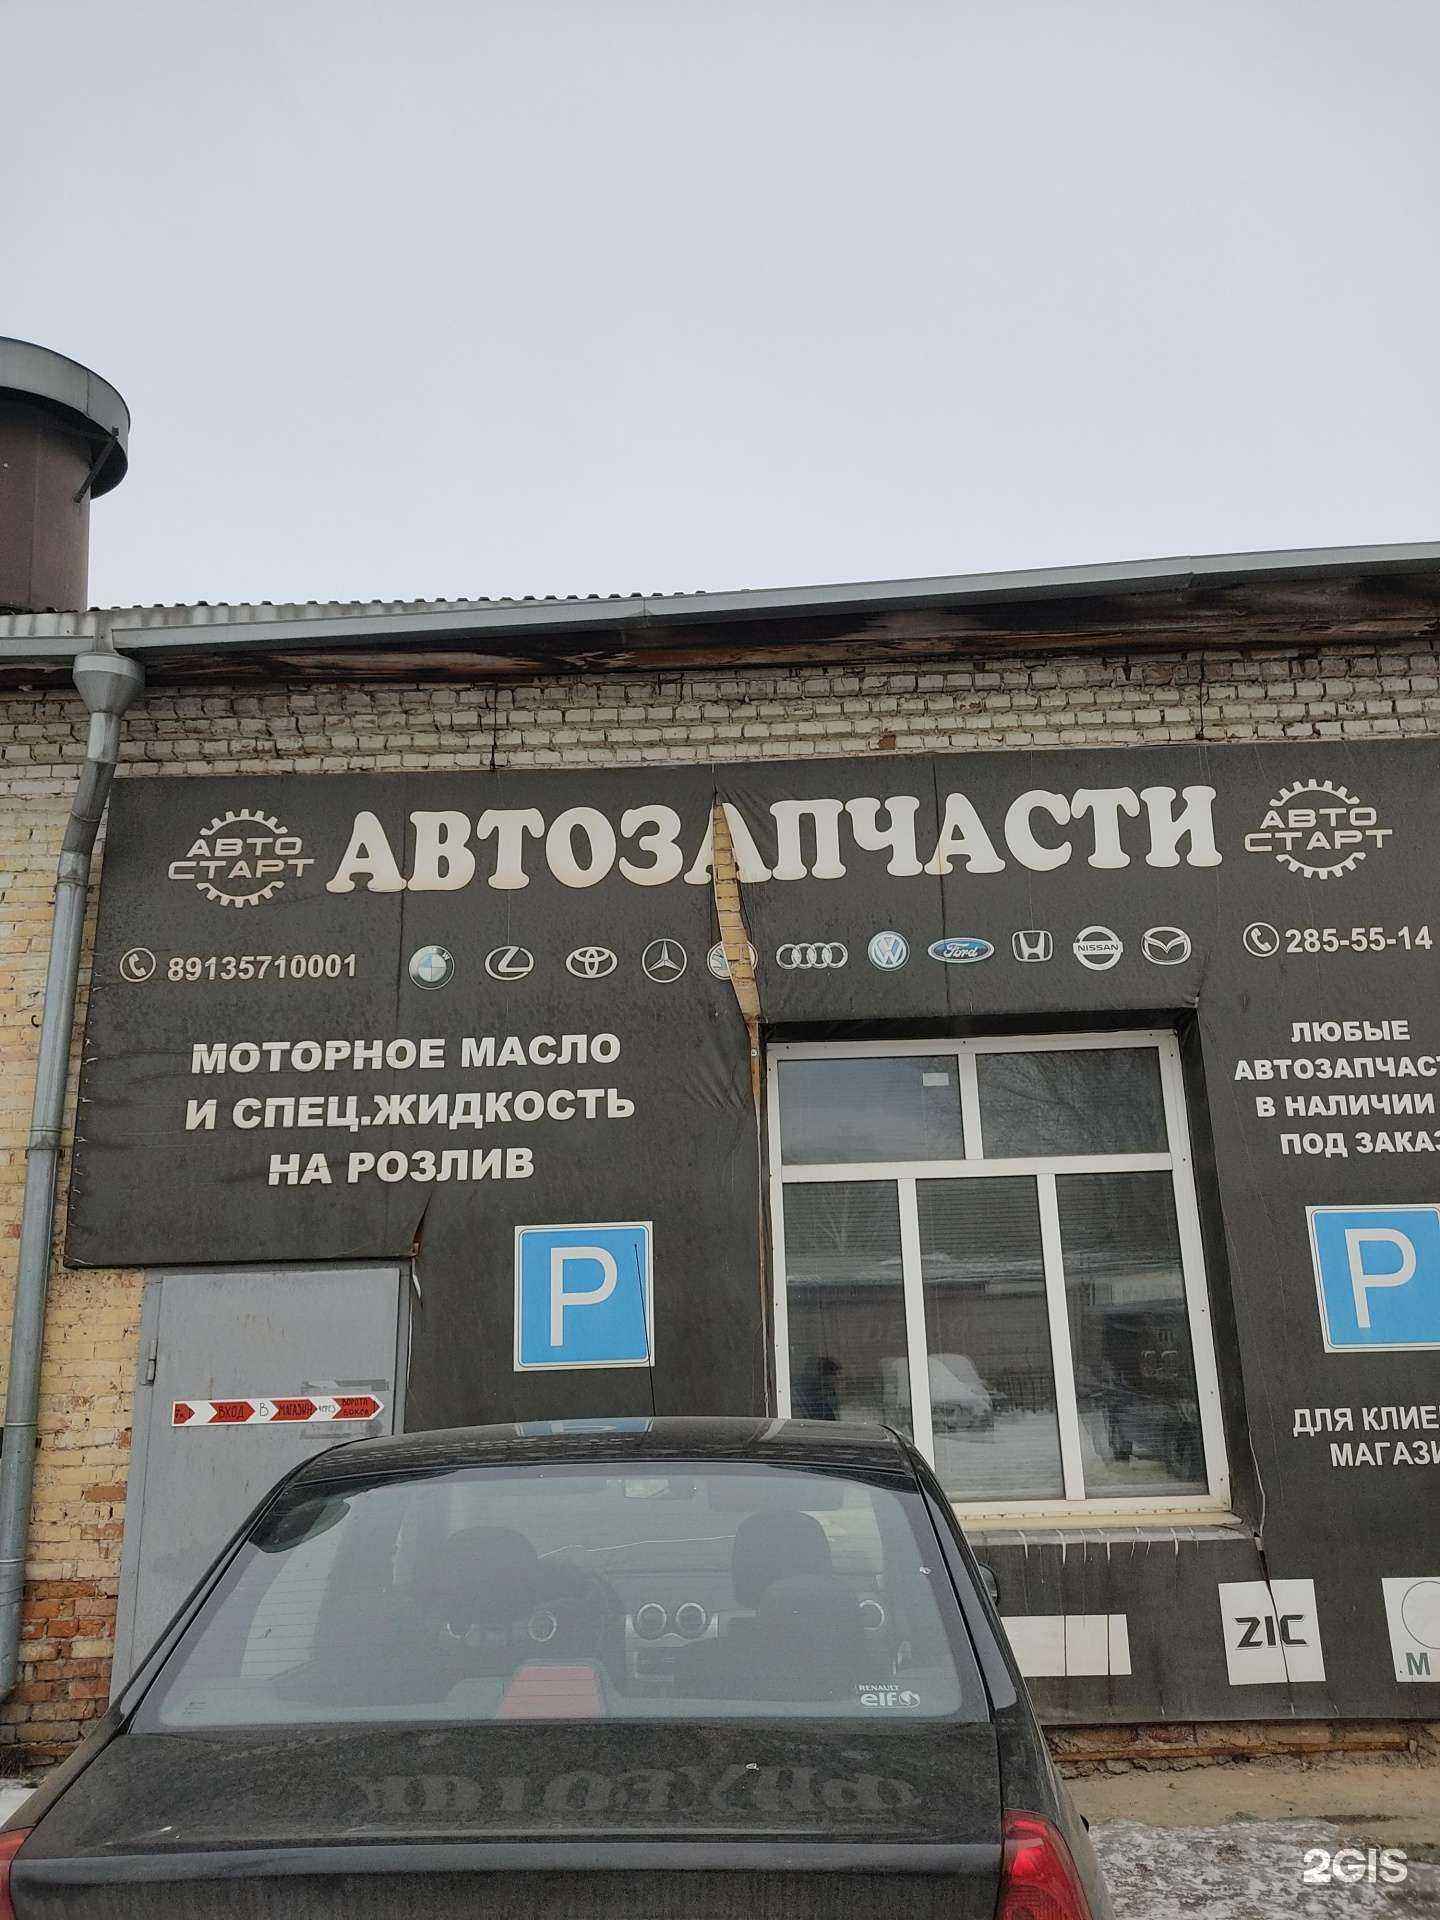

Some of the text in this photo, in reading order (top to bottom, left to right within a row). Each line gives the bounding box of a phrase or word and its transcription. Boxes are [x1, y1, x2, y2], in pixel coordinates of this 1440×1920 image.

[1259, 806, 1377, 829] АВТО
[186, 836, 303, 858] АВТО
[326, 785, 1223, 893] АВТОЗАПЧАСТИ
[1244, 829, 1393, 852] СТАРТ
[168, 858, 315, 880] СТАРТ
[943, 942, 978, 958] Ford
[1077, 944, 1119, 952] NISSAN
[1285, 925, 1433, 953] 285-55-14
[167, 953, 356, 982] 89135710001
[1291, 1020, 1411, 1043] ЛЮБЫЕ
[191, 1033, 621, 1074] МОТОРНОЕ МАСЛО
[1234, 1055, 1440, 1081] АВТОЗАПЧАС
[185, 1088, 635, 1133] И СПЕЦ.ЖИДКОСТЬ
[1255, 1093, 1435, 1118] В НАЛИЧИИ
[1280, 1132, 1349, 1158] ПОД
[268, 1147, 534, 1186] НА РОЗЛИВ
[1344, 1228, 1417, 1328] P
[551, 1246, 618, 1347] P
[218, 1404, 244, 1420] ВХОД
[259, 1402, 269, 1417] В
[1292, 1405, 1440, 1437] ДЛЯ КЛИЕ
[1234, 1613, 1308, 1649] ZIC
[858, 1684, 899, 1692] RENAULT
[860, 1692, 897, 1706] elf
